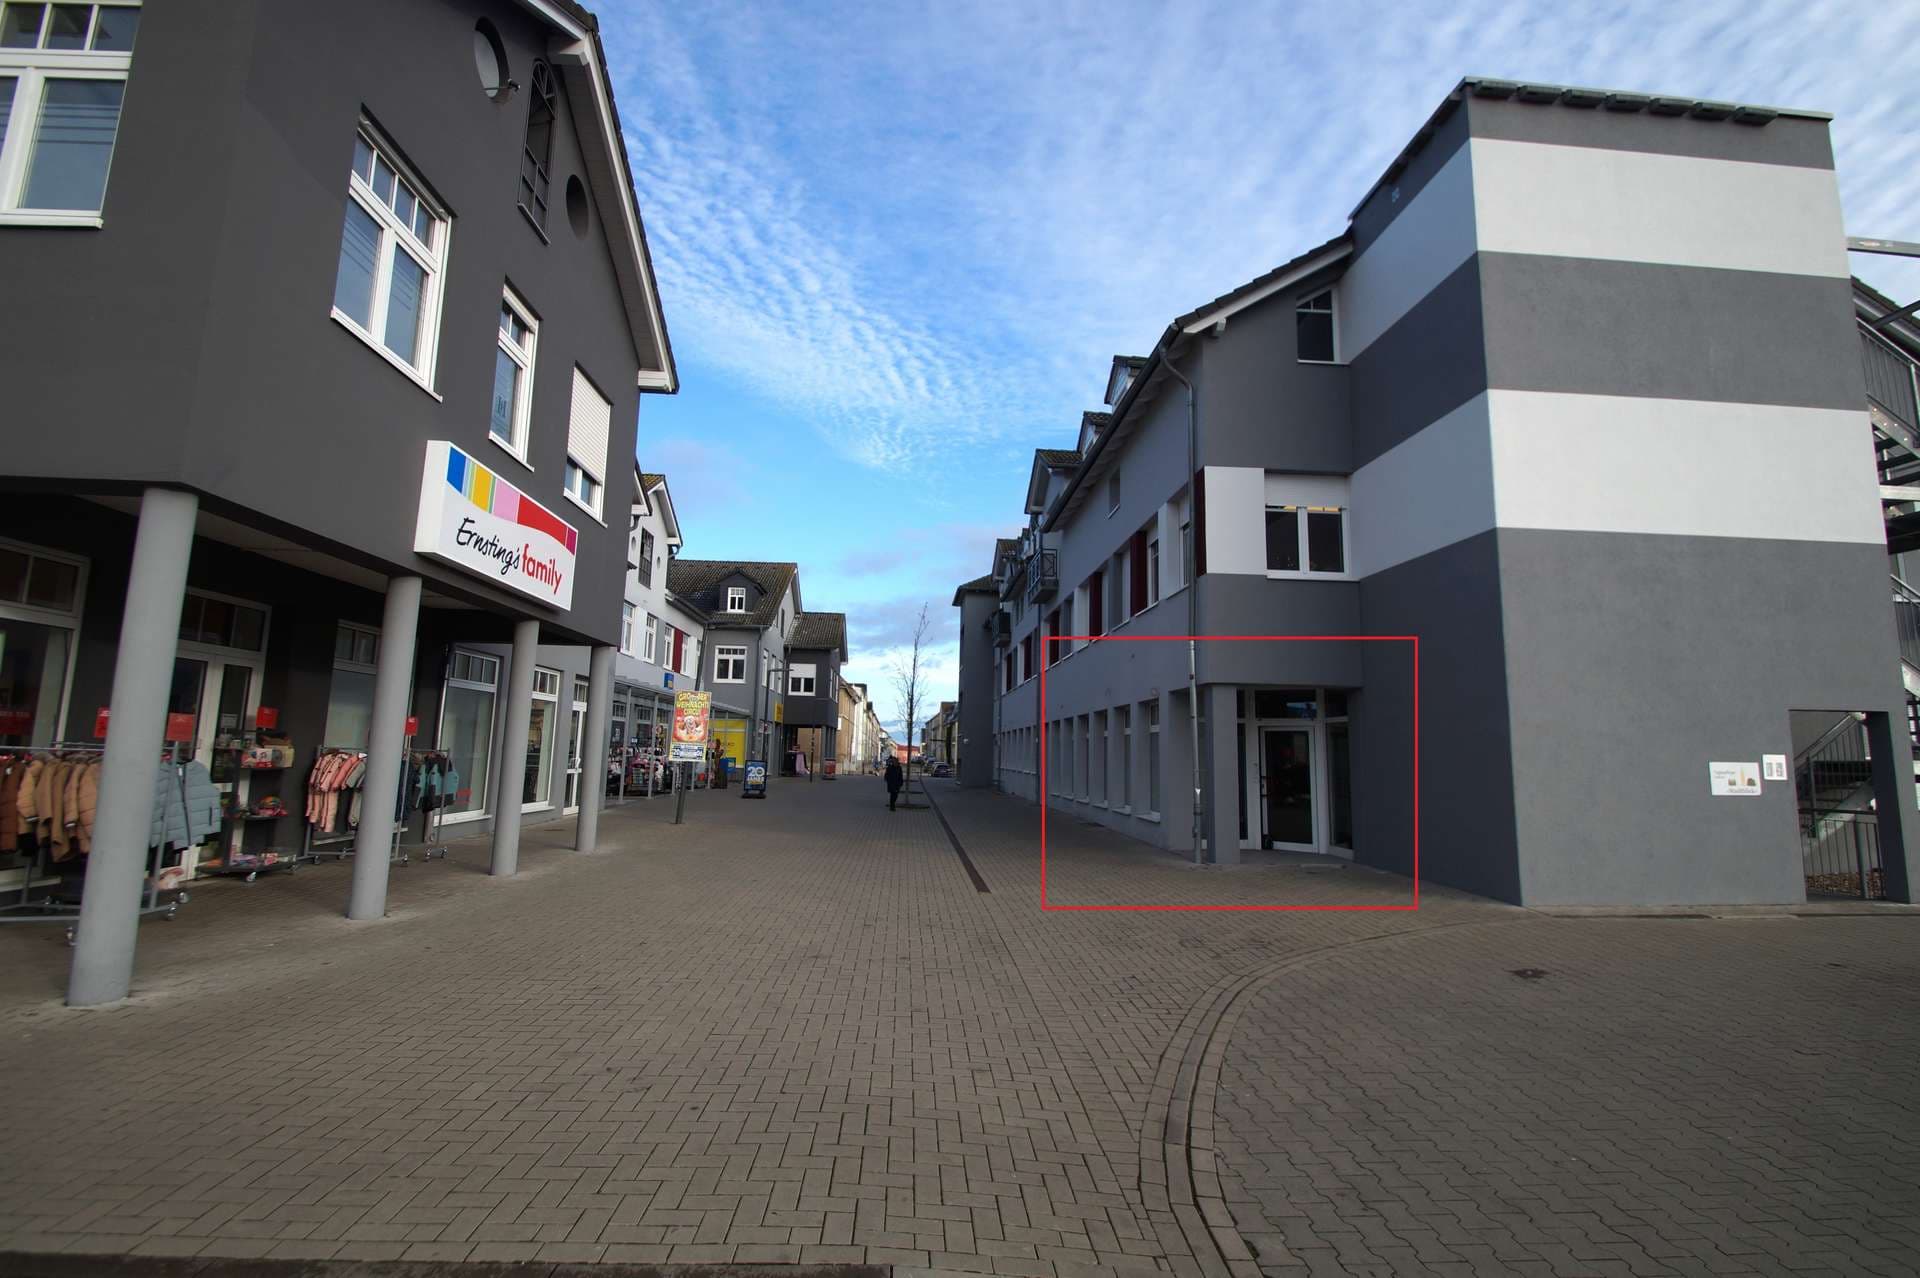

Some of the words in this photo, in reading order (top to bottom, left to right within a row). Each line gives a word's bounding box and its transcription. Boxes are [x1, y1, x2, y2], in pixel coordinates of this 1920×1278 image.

[456, 517, 520, 576] Ernsting's
[522, 543, 563, 595] family
[747, 766, 765, 777] 20
